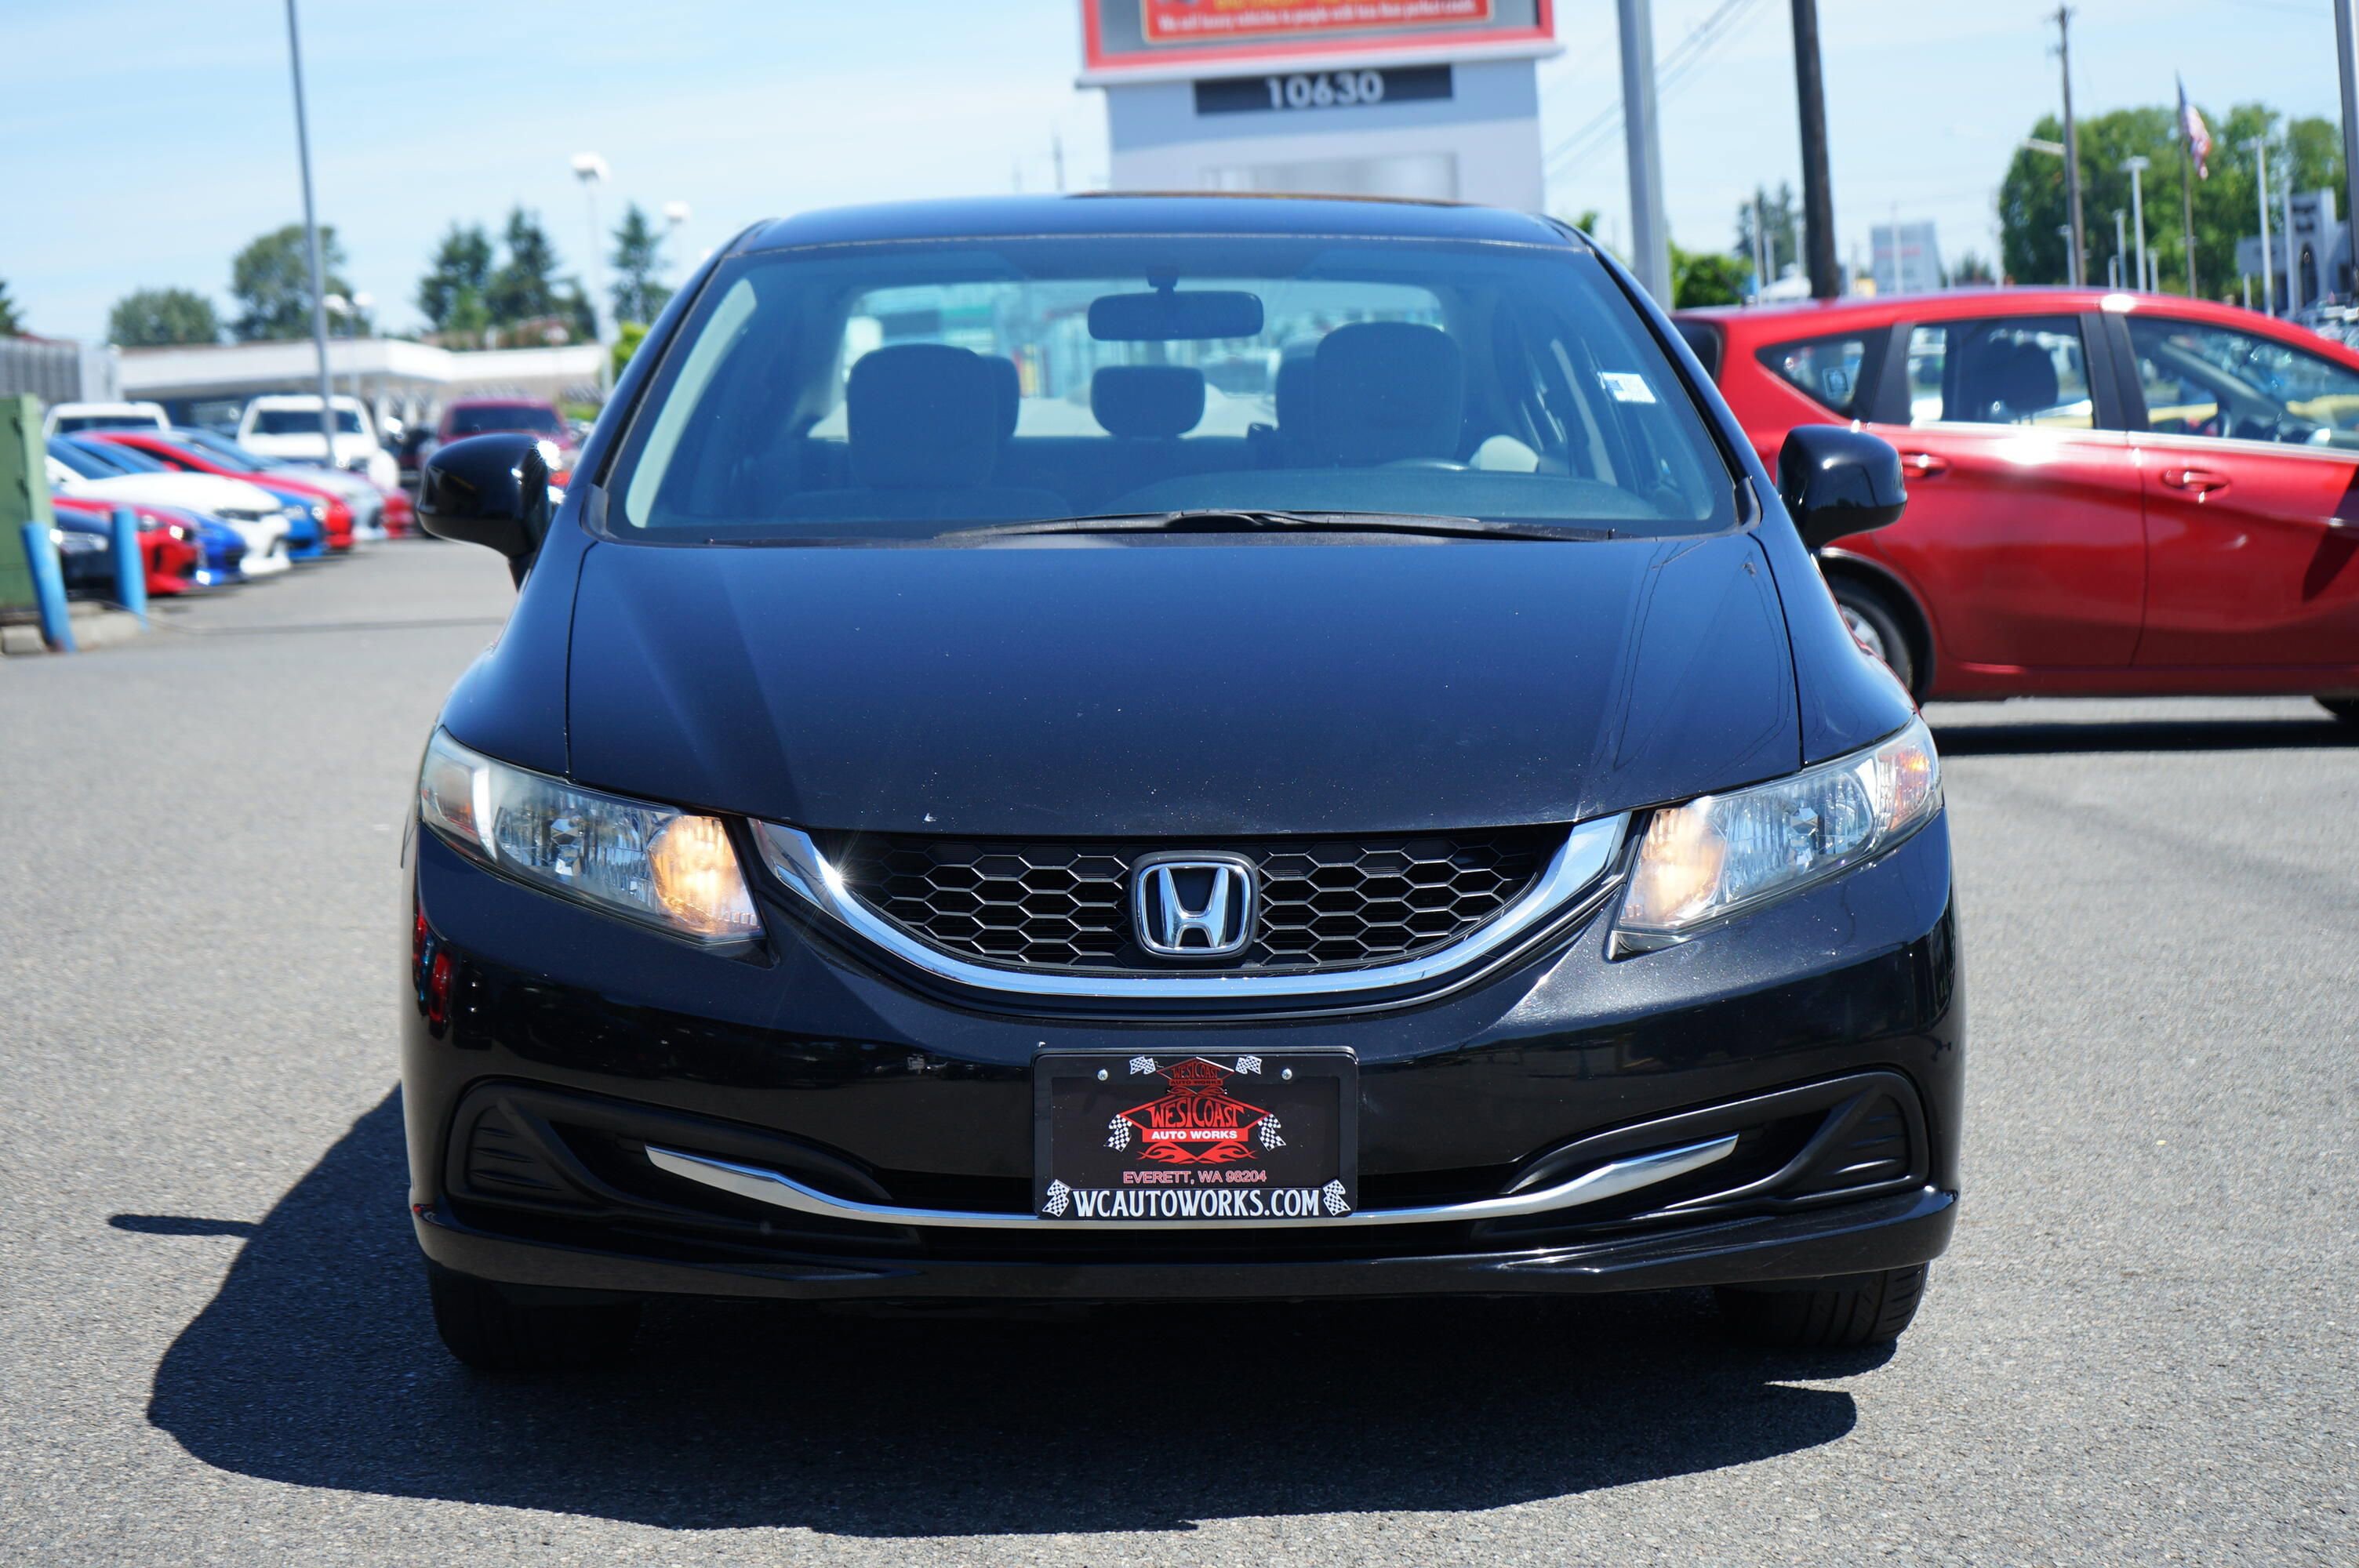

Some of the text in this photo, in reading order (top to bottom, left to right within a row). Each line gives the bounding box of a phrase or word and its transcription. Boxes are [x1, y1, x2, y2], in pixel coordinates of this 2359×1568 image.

[1266, 69, 1384, 109] 10630
[1151, 1130, 1238, 1140] AUTO WORKS
[1123, 1171, 1267, 1185] EVERETT, WA 98204
[1073, 1189, 1319, 1217] WCAUTOWORKS.COM
